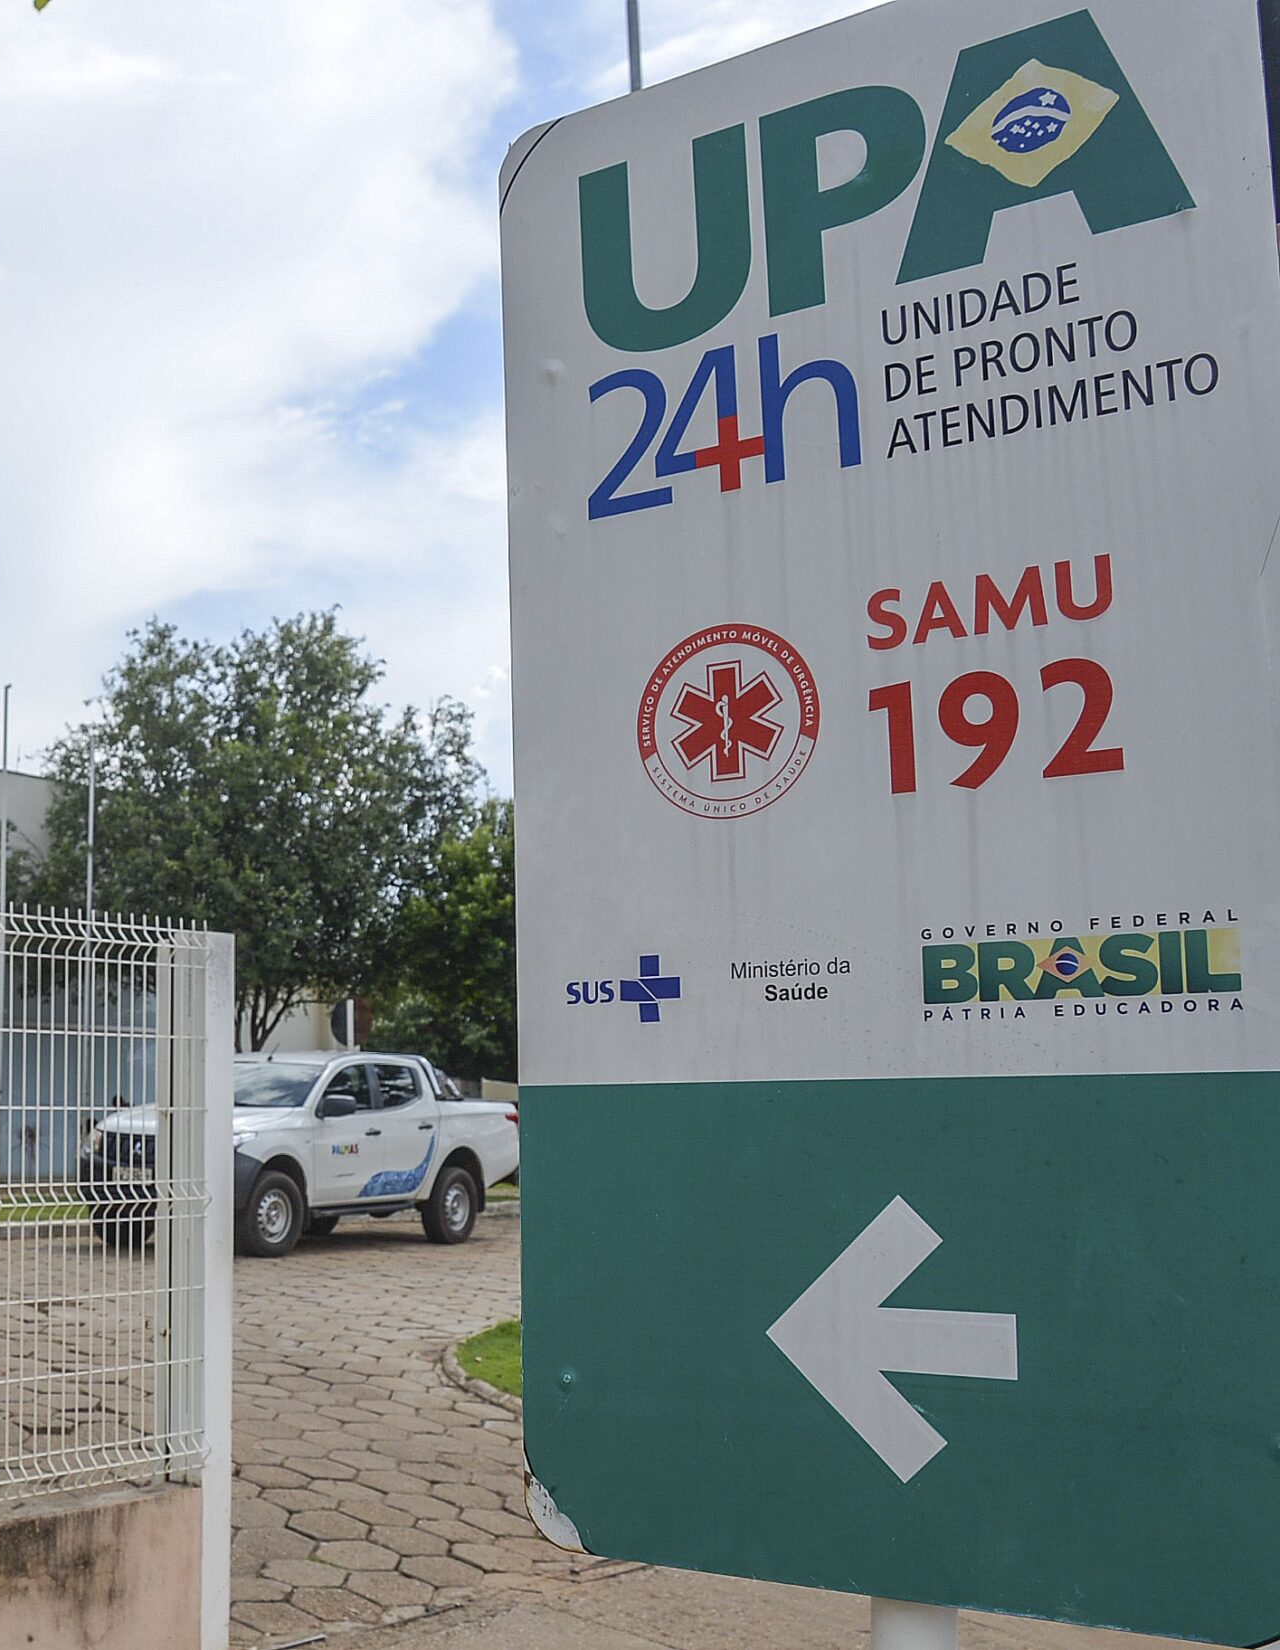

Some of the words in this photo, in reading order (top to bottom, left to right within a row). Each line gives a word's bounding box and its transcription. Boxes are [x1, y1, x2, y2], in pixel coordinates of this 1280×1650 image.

[578, 8, 1197, 353] UPA
[880, 262, 1080, 345] UNIDADE
[883, 354, 937, 403] DE
[953, 310, 1138, 387] PRONTO
[588, 333, 862, 520] 24h
[886, 352, 1220, 459] ATENDIMENTO
[866, 553, 1113, 651] SAMU
[642, 696, 655, 748] SERVIÇO
[651, 677, 663, 692] DE
[662, 630, 738, 676] ATENDIMENTO
[741, 631, 780, 653] MÓVEL
[780, 650, 793, 665] DE
[793, 665, 815, 728] URGÊNCIA
[868, 657, 1125, 795] 192
[652, 766, 696, 808] SISTEMA
[704, 801, 747, 814] ÚNICO
[755, 793, 770, 805] DE
[776, 750, 807, 790] SAÚDE
[921, 919, 1063, 941] GOVERNO
[1089, 908, 1238, 930] FEDERAL
[566, 980, 615, 1005] SUS
[730, 958, 821, 980] Ministério
[827, 956, 851, 975] da
[764, 983, 829, 1002] Saúde
[921, 929, 1242, 1004] BRASIL
[923, 1005, 1026, 1022] PÁTRIA
[1054, 998, 1243, 1018] EDUCADORA
